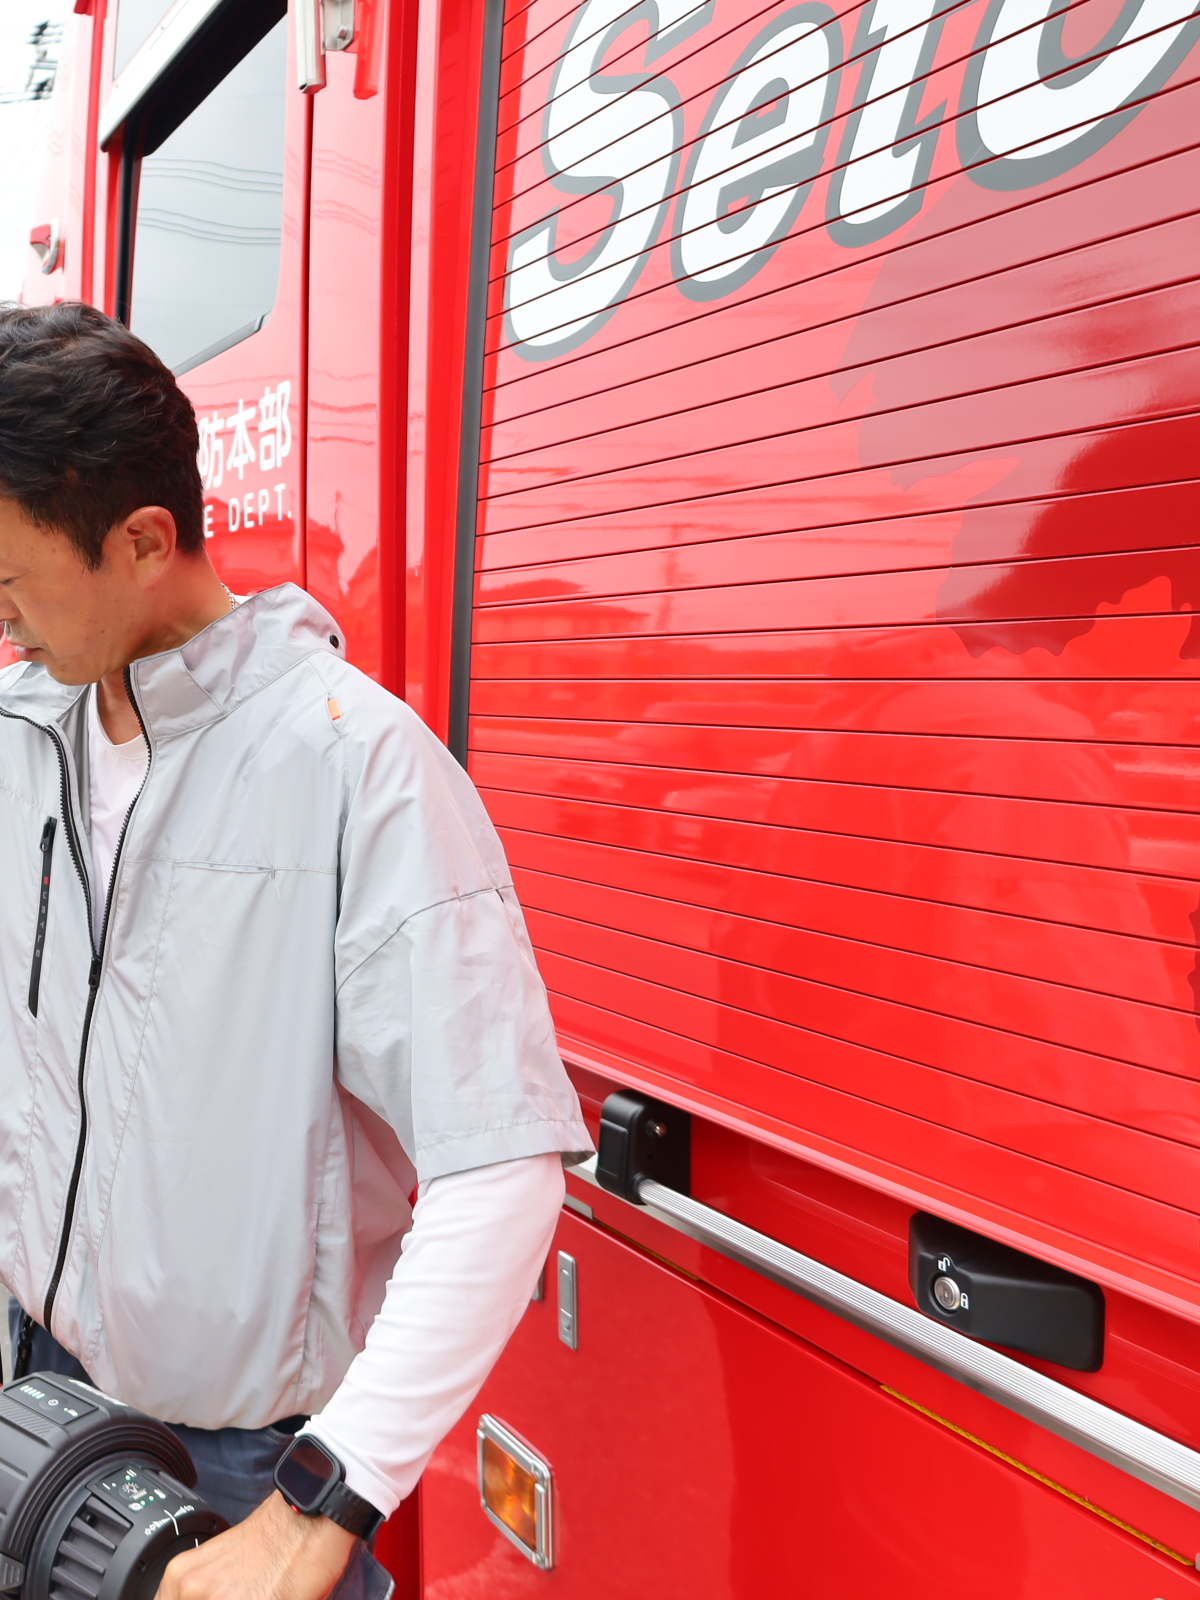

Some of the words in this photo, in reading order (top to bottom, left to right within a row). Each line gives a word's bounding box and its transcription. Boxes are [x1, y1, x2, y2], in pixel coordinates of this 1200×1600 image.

[198, 380, 292, 491] 防本部
[228, 483, 293, 532] DEPT.
[35, 876, 50, 957] URTLE
